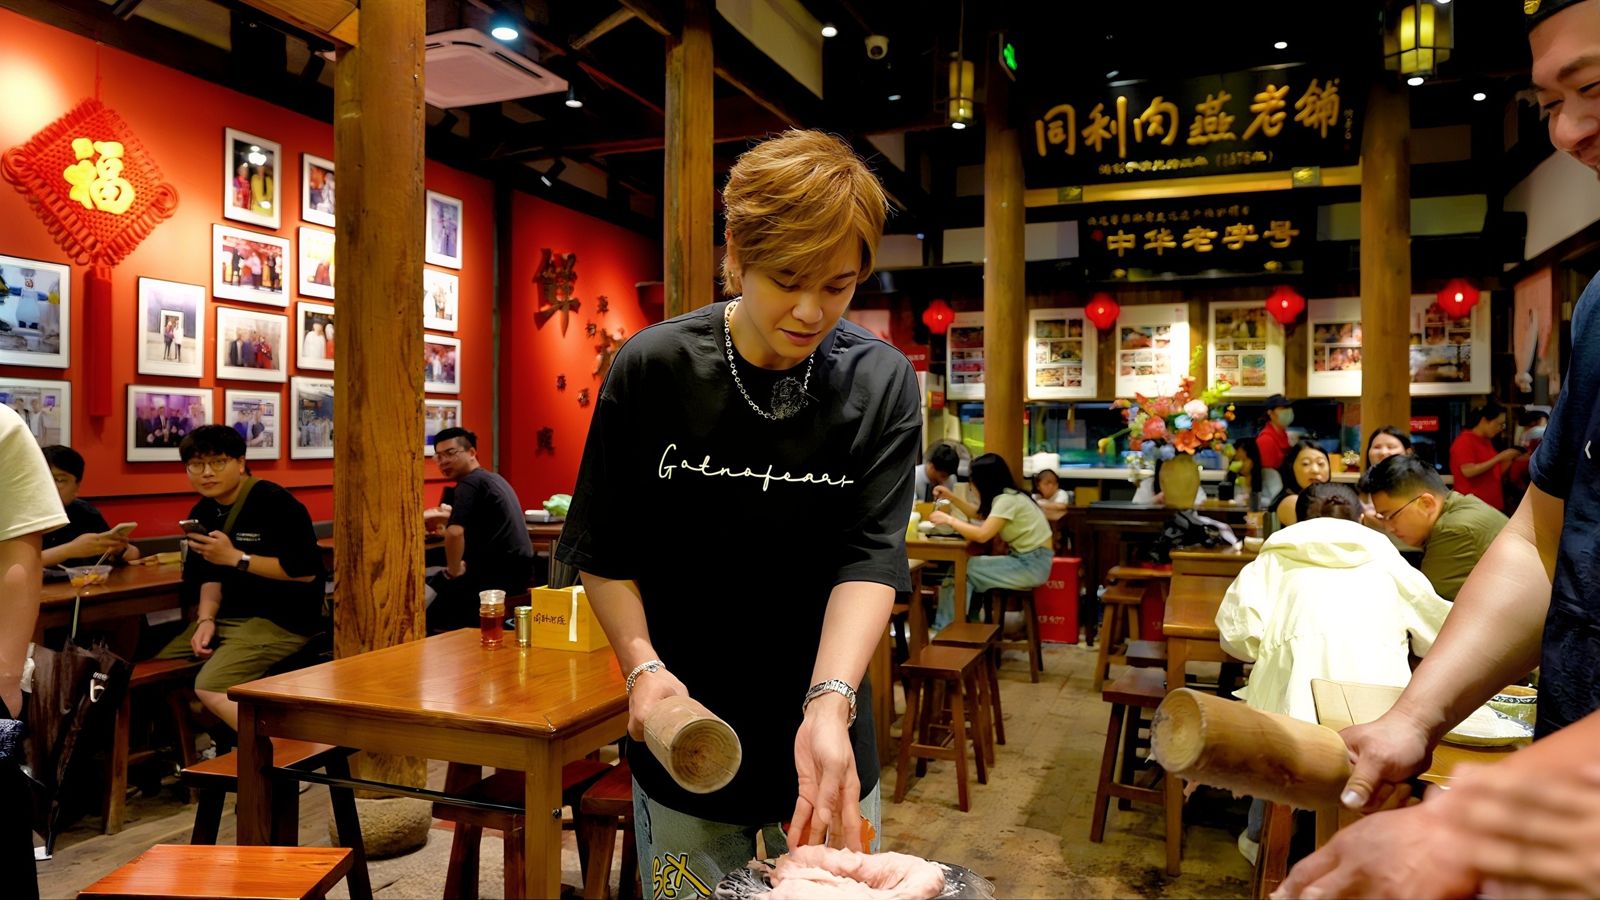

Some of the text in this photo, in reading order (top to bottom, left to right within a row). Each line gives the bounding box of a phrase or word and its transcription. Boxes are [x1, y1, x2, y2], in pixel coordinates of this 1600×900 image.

[63, 137, 136, 214] 福
[1106, 219, 1300, 257] 中华老字号
